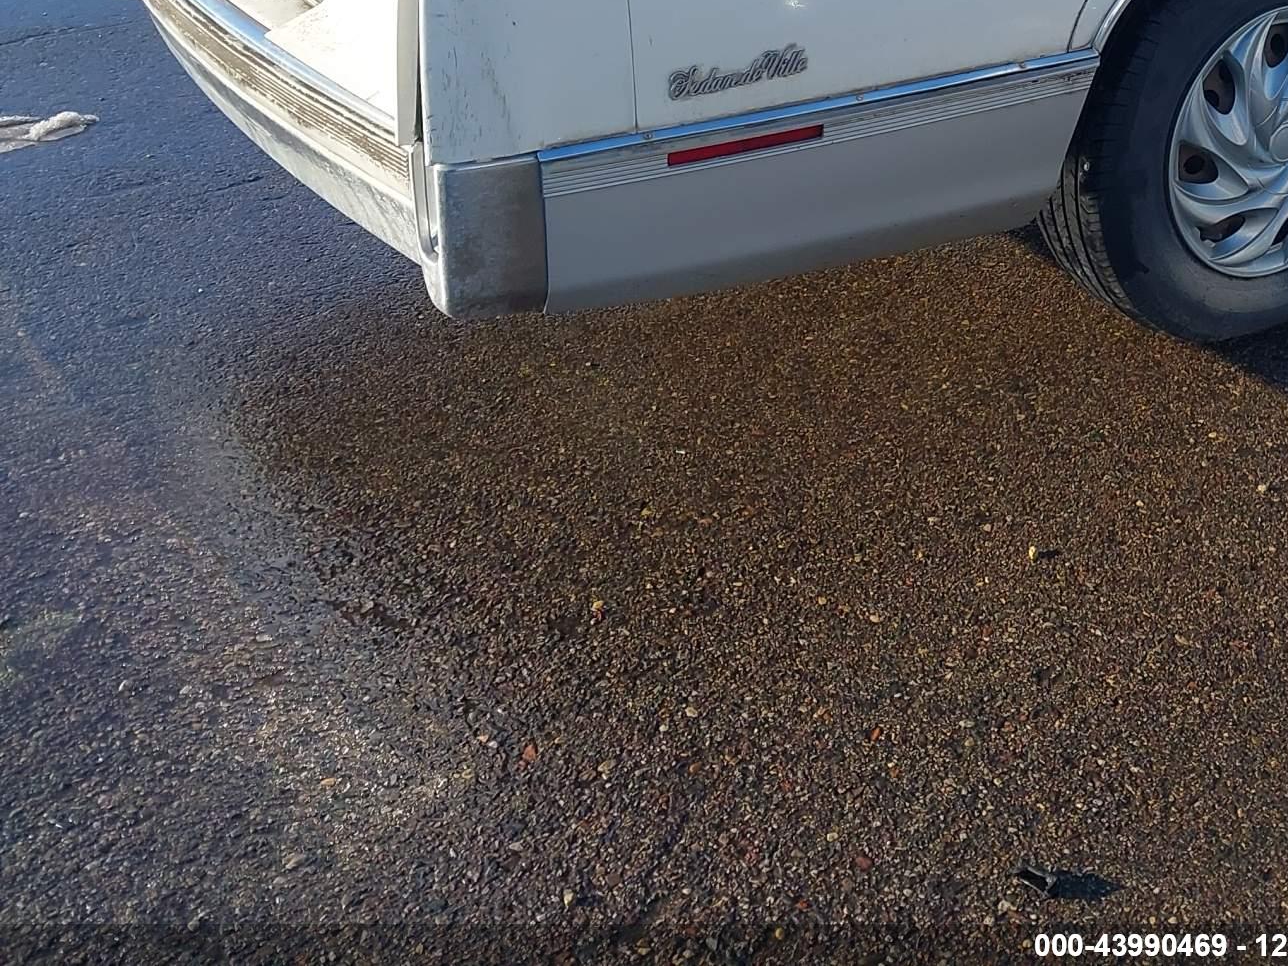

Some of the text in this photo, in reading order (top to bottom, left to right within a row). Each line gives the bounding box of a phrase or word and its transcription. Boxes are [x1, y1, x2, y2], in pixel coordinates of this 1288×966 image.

[668, 42, 809, 101] Sedan de Ville
